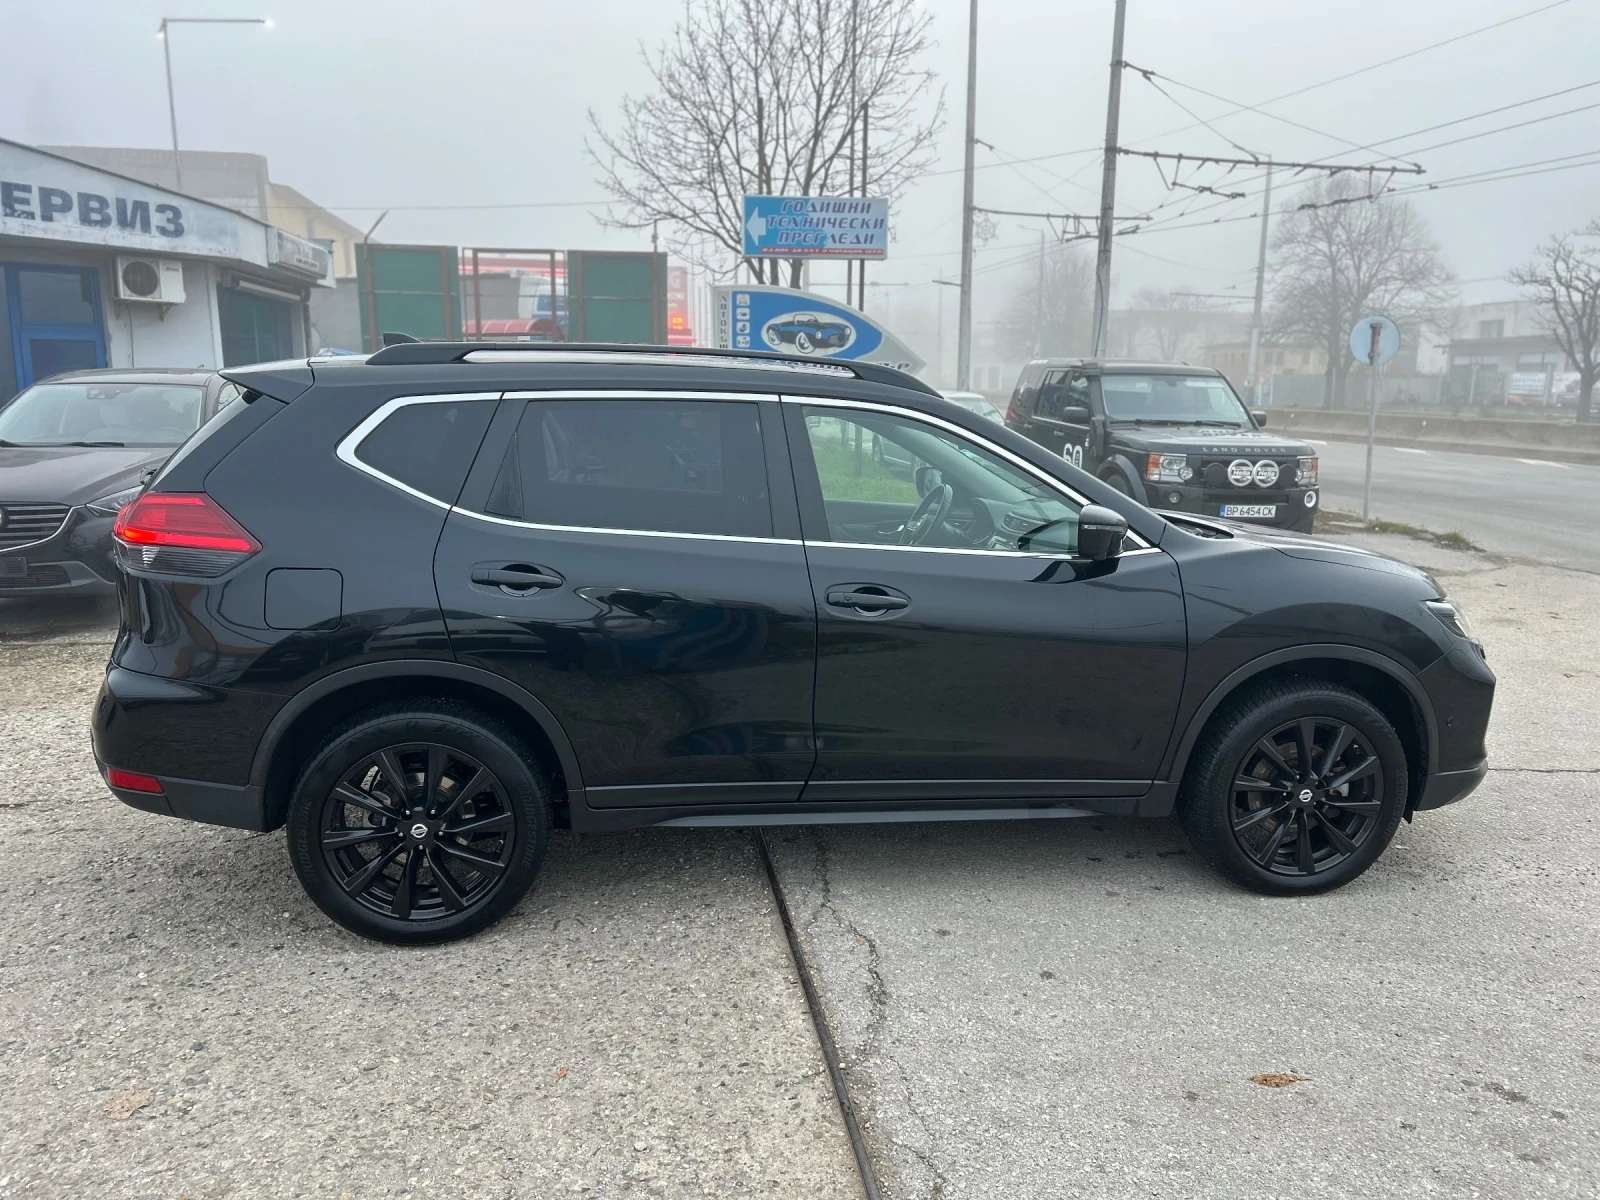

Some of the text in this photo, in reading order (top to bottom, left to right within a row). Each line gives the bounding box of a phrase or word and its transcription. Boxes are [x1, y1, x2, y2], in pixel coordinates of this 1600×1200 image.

[781, 199, 872, 215] ГОДИШНИ
[767, 215, 885, 230] ТЕХНИЧЕСКИ
[777, 230, 875, 245] ПРЕГЛЕДИ
[1240, 507, 1260, 516] 6454
